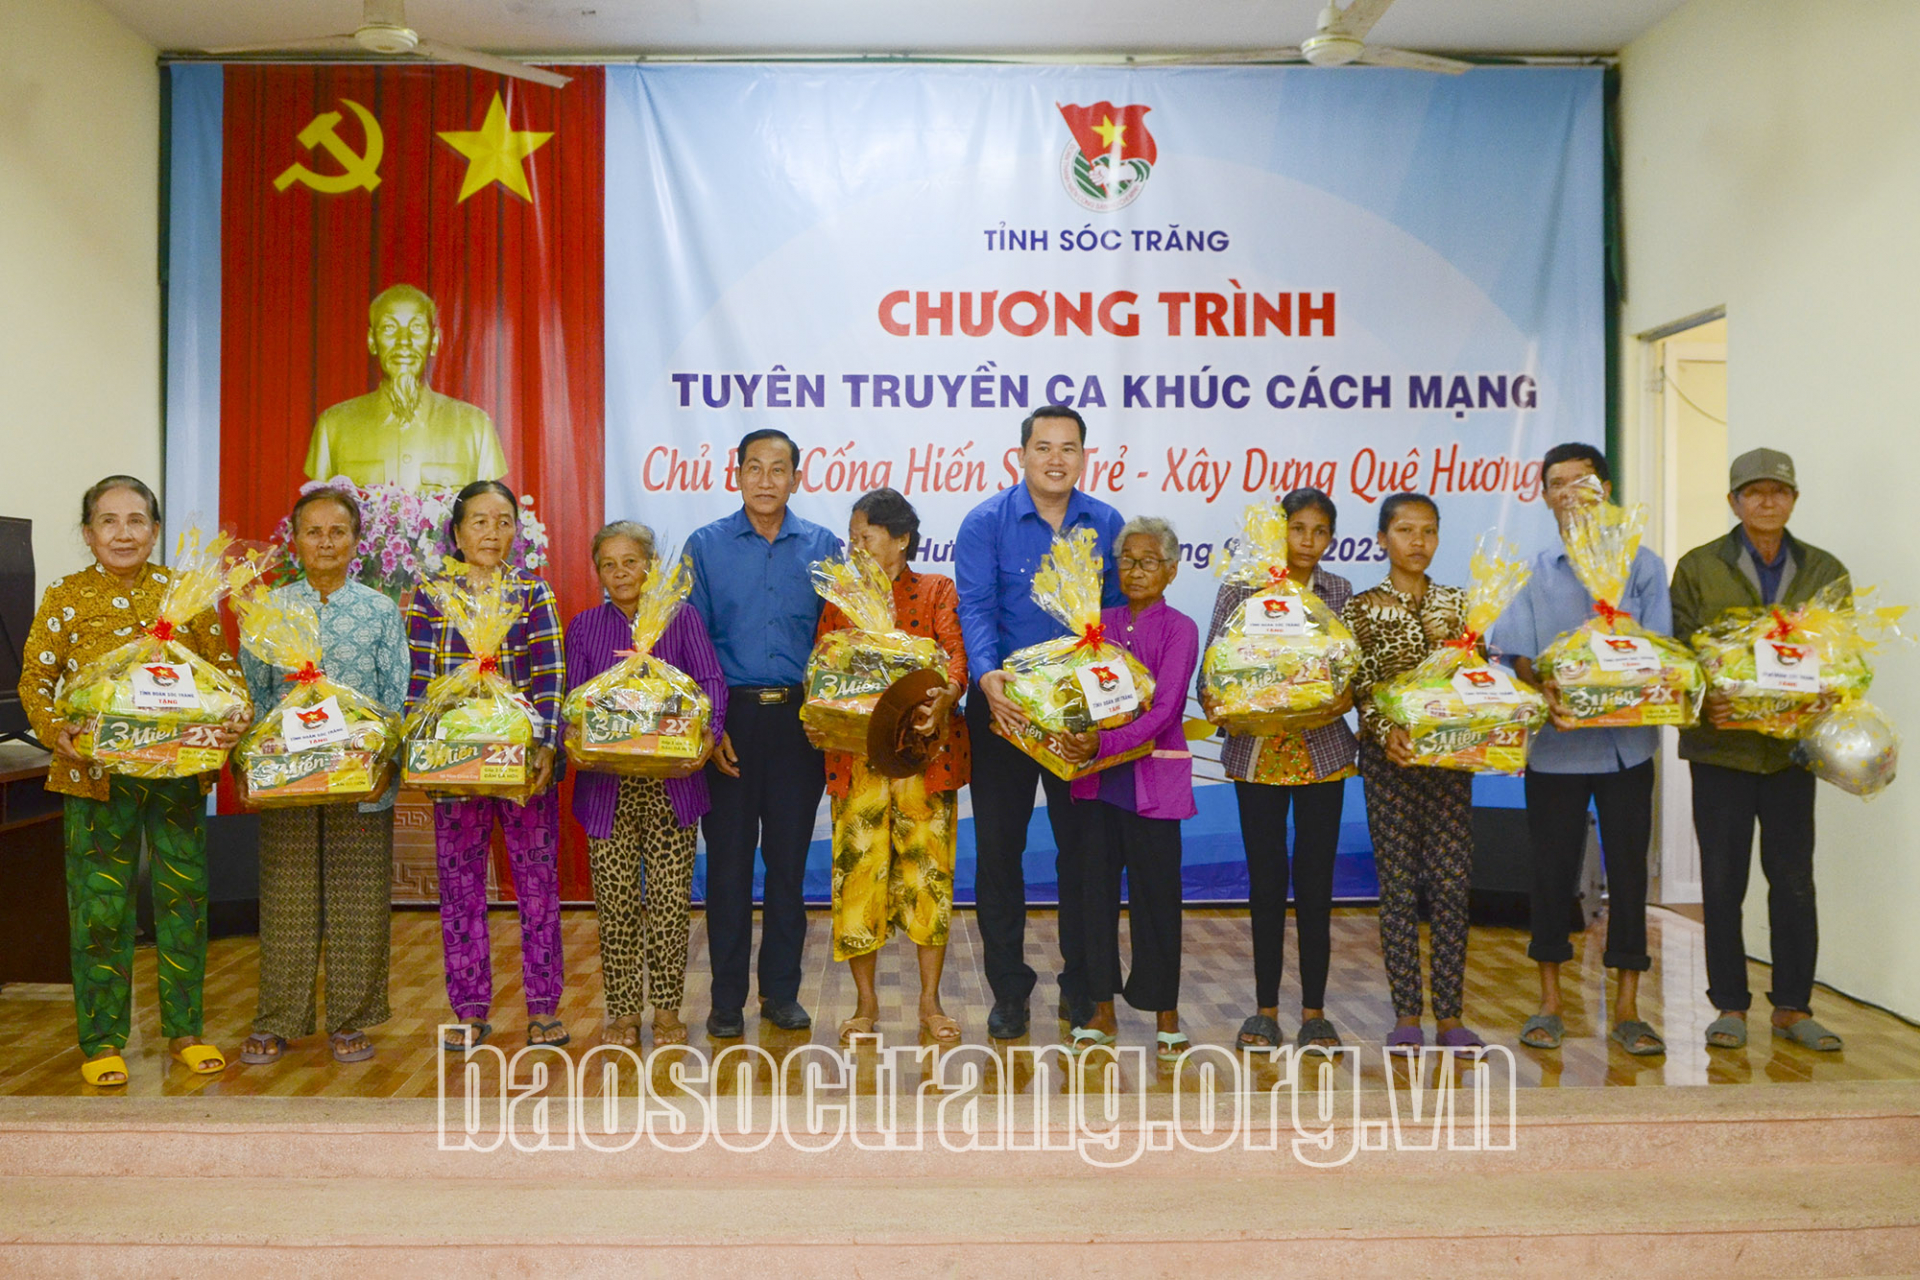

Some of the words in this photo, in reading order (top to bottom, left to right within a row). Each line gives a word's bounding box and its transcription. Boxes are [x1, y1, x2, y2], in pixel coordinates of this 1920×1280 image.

[984, 221, 1049, 251] TỈNH
[1059, 223, 1123, 252] SÓC
[1131, 224, 1230, 252] TRĂNG
[878, 290, 1141, 337] CHƯƠNG
[1158, 278, 1336, 337] TRÌNH
[672, 364, 826, 408] TUYÊN
[842, 361, 1030, 408] TRUYỀN
[1045, 374, 1107, 408] CA
[1123, 366, 1251, 409] KHÚC
[1266, 366, 1391, 409] CÁCH
[1409, 374, 1538, 418] MẠNG
[643, 444, 714, 492] Chủ
[801, 441, 892, 492] Cống
[904, 440, 987, 496] Hiến
[1162, 446, 1232, 503] Xây
[1242, 447, 1338, 502] Dựng
[1350, 446, 1421, 503] Quê
[1428, 444, 1546, 502] Hương
[1320, 537, 1389, 562] 2023
[665, 718, 690, 734] 2X
[485, 744, 521, 764] 2X
